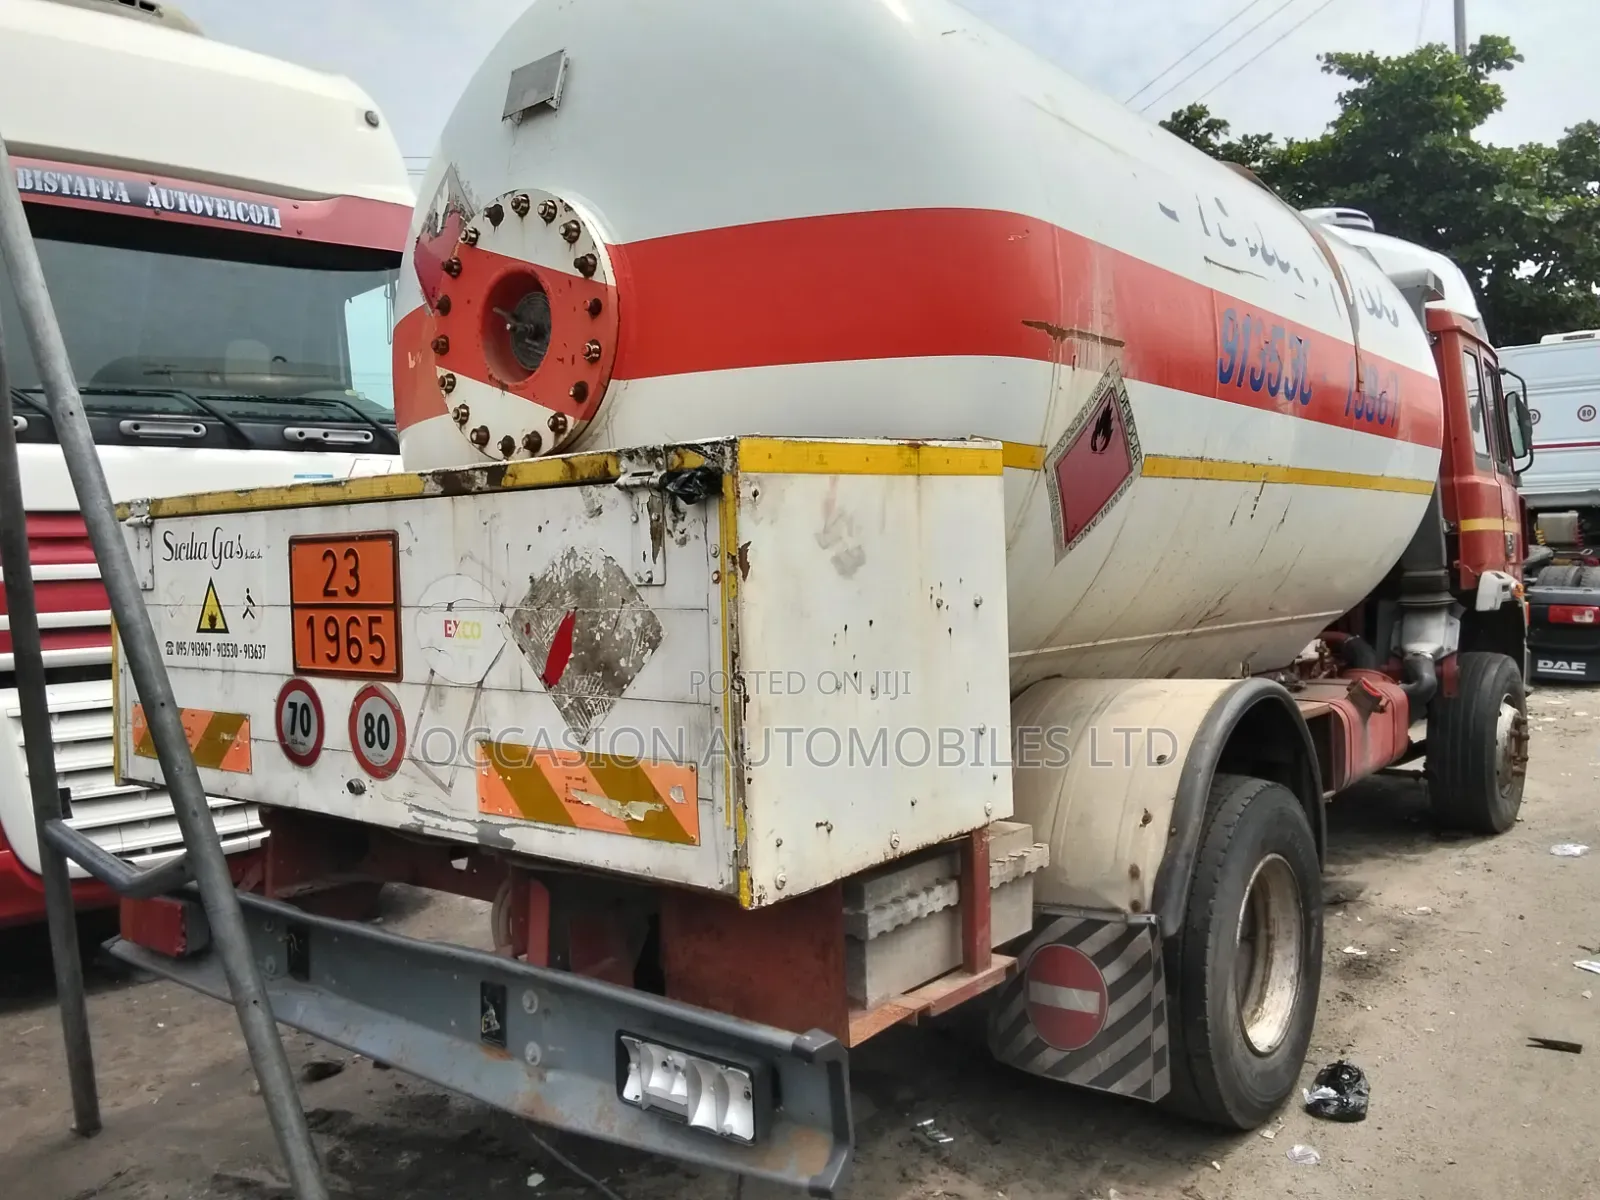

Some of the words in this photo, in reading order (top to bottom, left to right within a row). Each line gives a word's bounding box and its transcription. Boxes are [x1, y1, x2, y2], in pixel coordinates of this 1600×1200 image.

[16, 168, 130, 203] BISTAFFA
[146, 186, 281, 229] AUTOVEICOLI
[162, 530, 208, 562] Sicilia
[211, 527, 243, 570] Gas
[322, 548, 360, 598] 23
[306, 614, 386, 666] 1965
[1537, 659, 1587, 671] DAF
[288, 701, 312, 737] 70
[364, 712, 390, 750] 80
